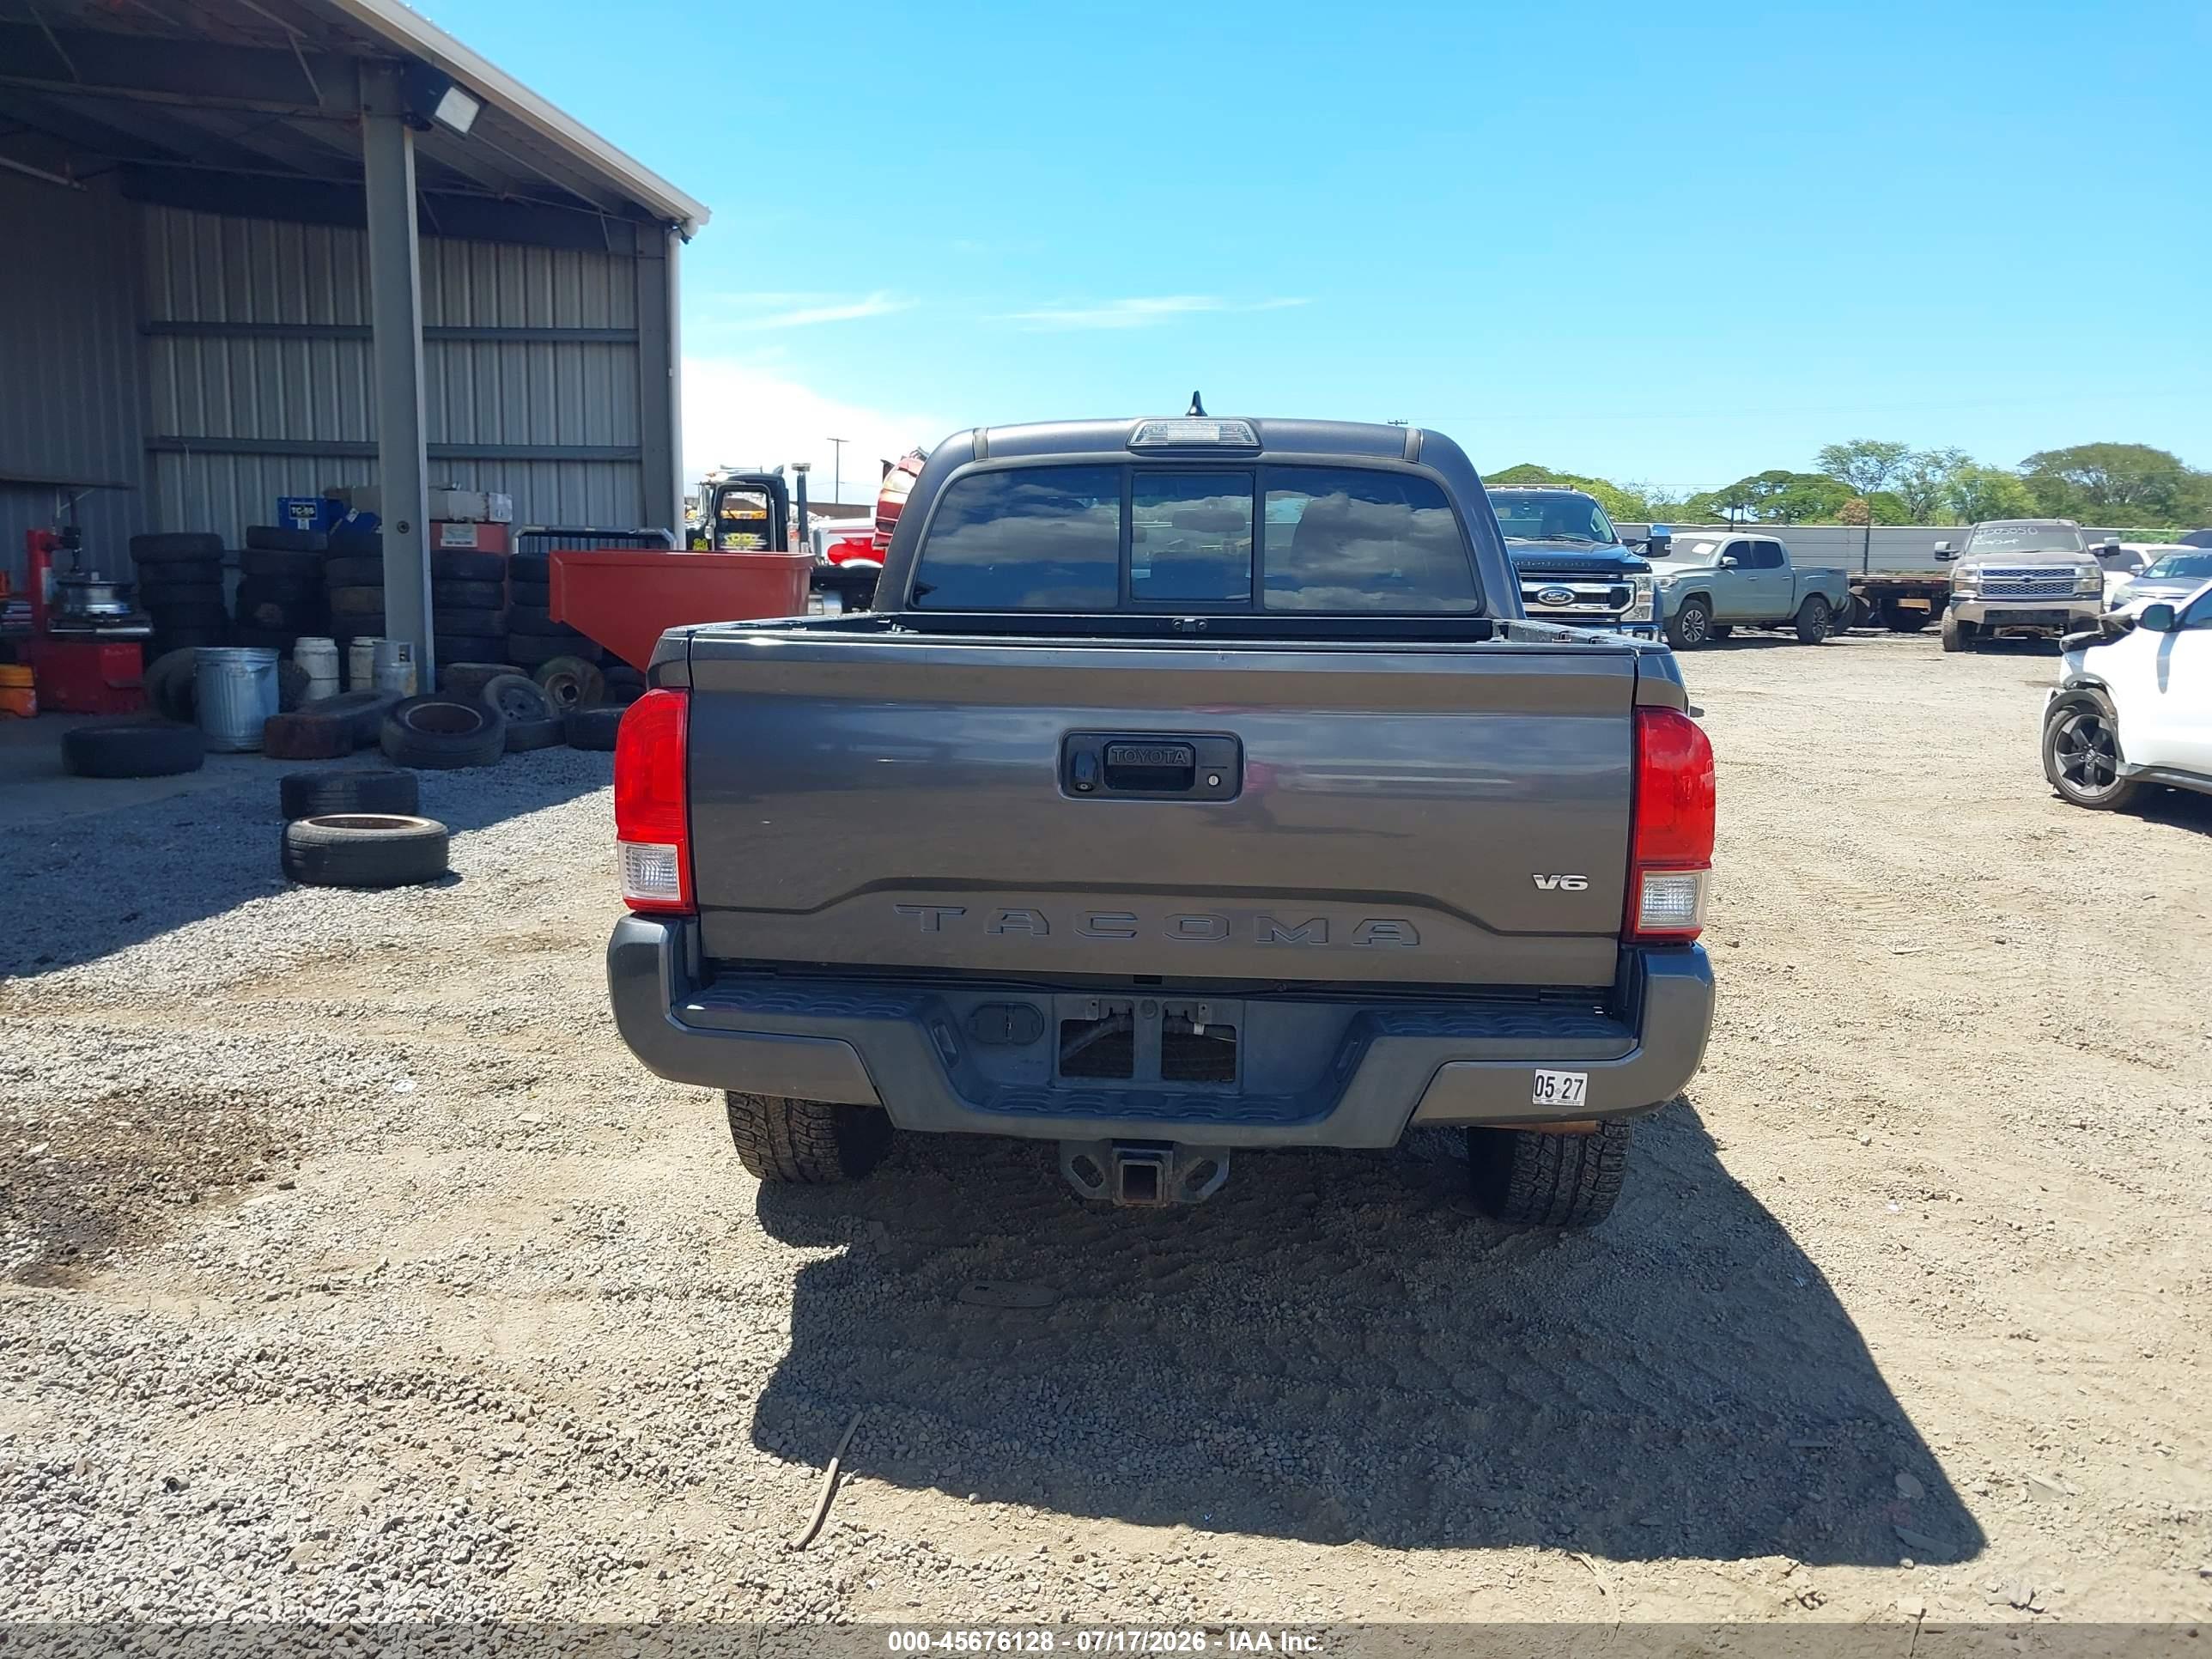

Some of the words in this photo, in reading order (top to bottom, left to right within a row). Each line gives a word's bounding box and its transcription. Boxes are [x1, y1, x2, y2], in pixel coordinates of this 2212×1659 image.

[1113, 749, 1187, 763] TOYOTA
[1532, 874, 1589, 890] V6
[894, 903, 1420, 946] TACOMA
[1534, 1074, 1556, 1098] 05
[1561, 1078, 1584, 1101] 27
